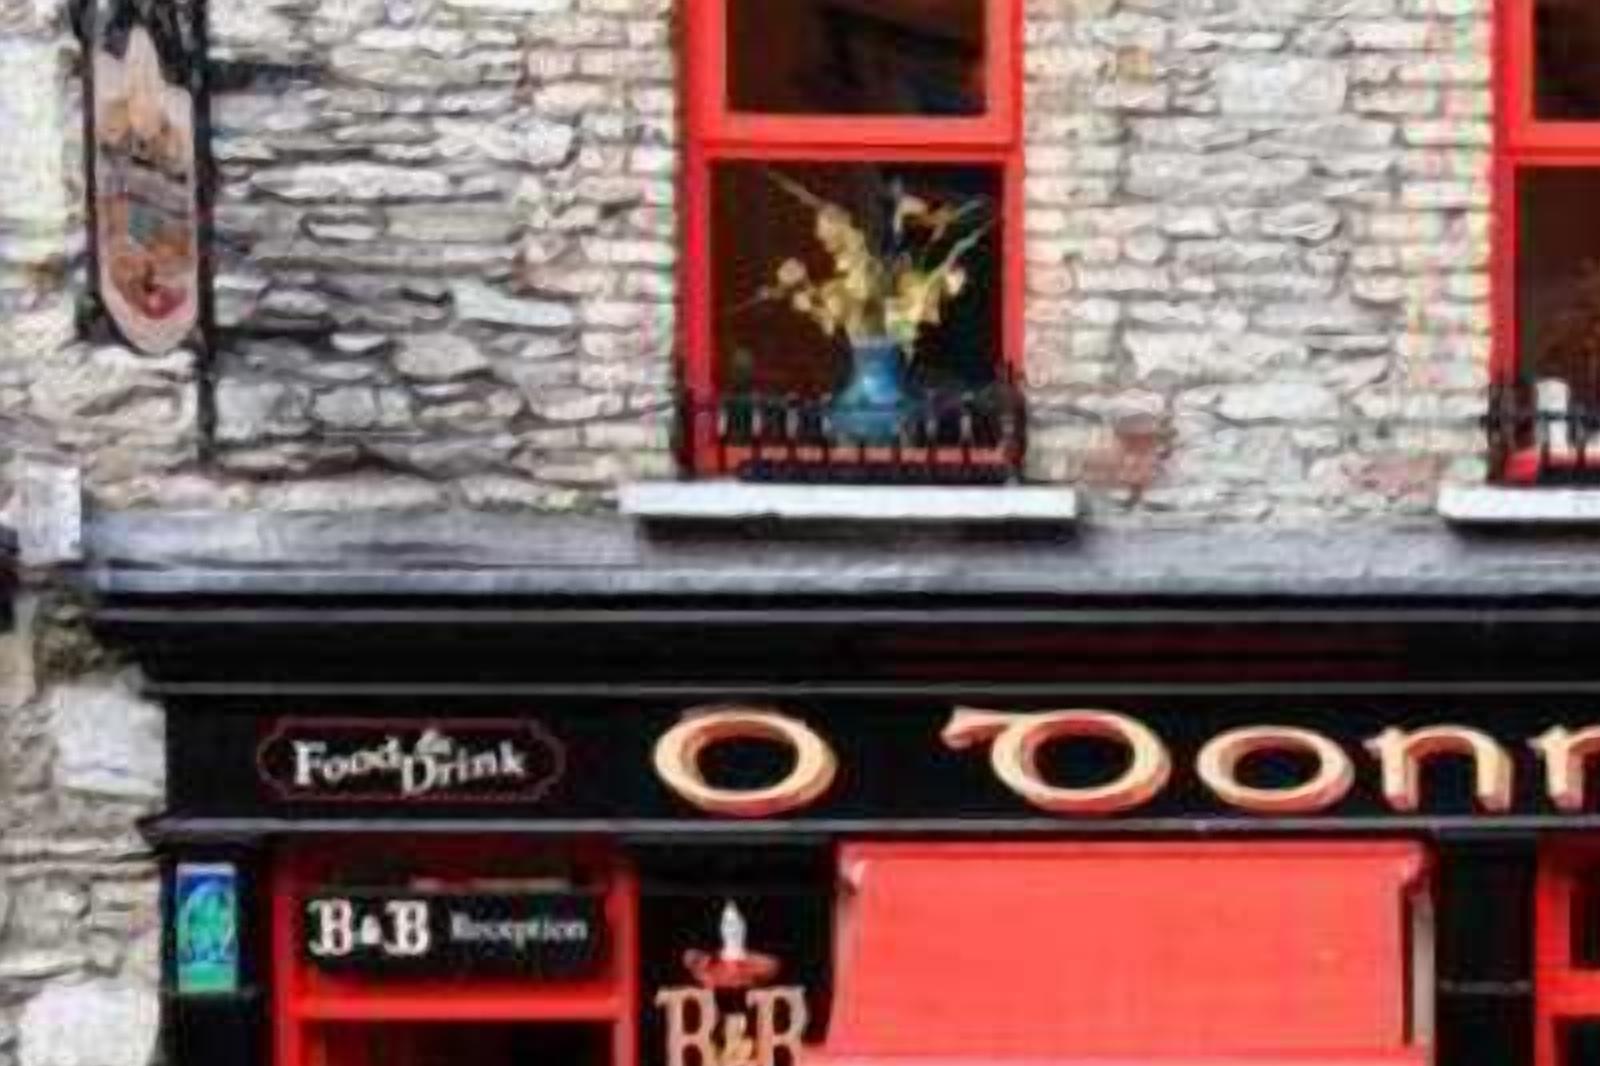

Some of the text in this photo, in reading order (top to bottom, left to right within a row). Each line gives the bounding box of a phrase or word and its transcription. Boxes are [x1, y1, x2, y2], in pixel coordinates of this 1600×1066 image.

[294, 735, 399, 786] Food
[402, 741, 525, 794] Drink
[655, 706, 838, 814] O
[308, 900, 589, 956] B&B Reception
